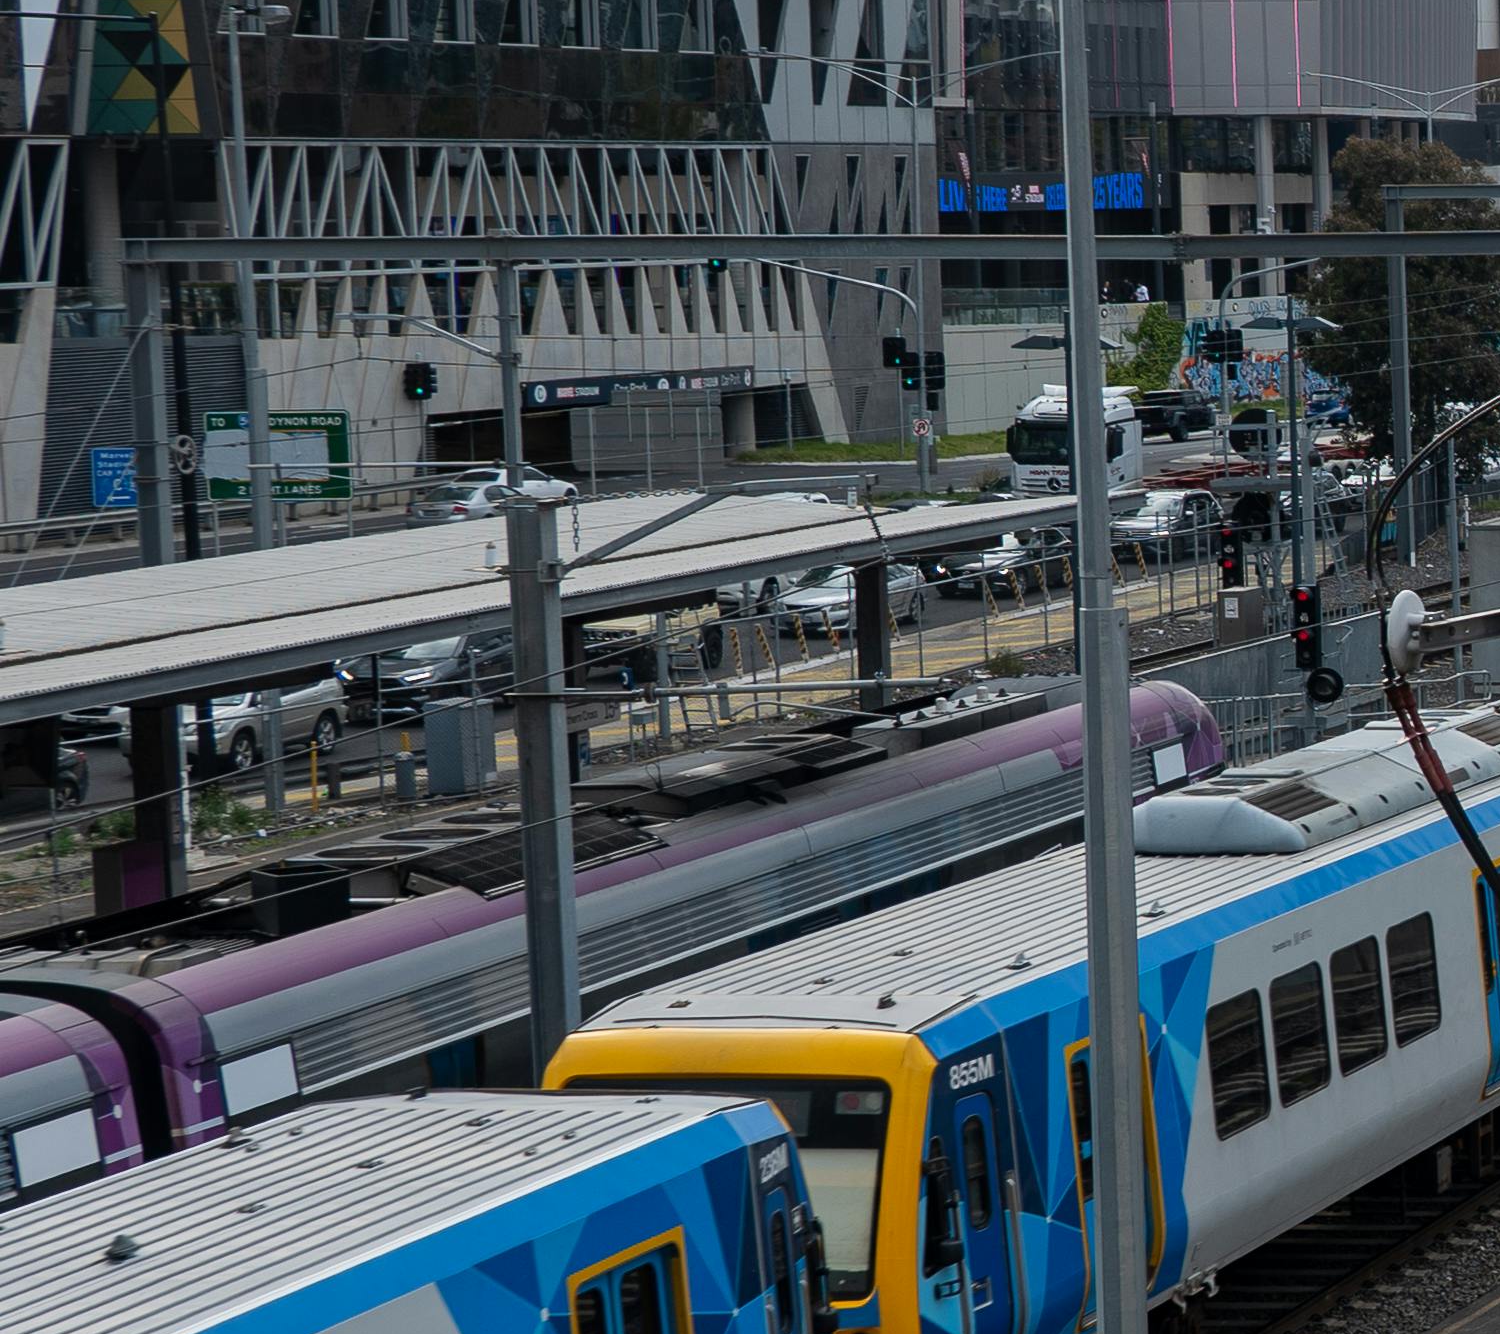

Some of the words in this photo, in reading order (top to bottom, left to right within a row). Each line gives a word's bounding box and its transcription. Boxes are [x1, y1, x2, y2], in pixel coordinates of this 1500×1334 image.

[1107, 172, 1144, 209] YEARS
[211, 417, 225, 427] TO
[310, 416, 342, 426] ROAD
[286, 484, 323, 495] LANES
[950, 1053, 995, 1090] 855M
